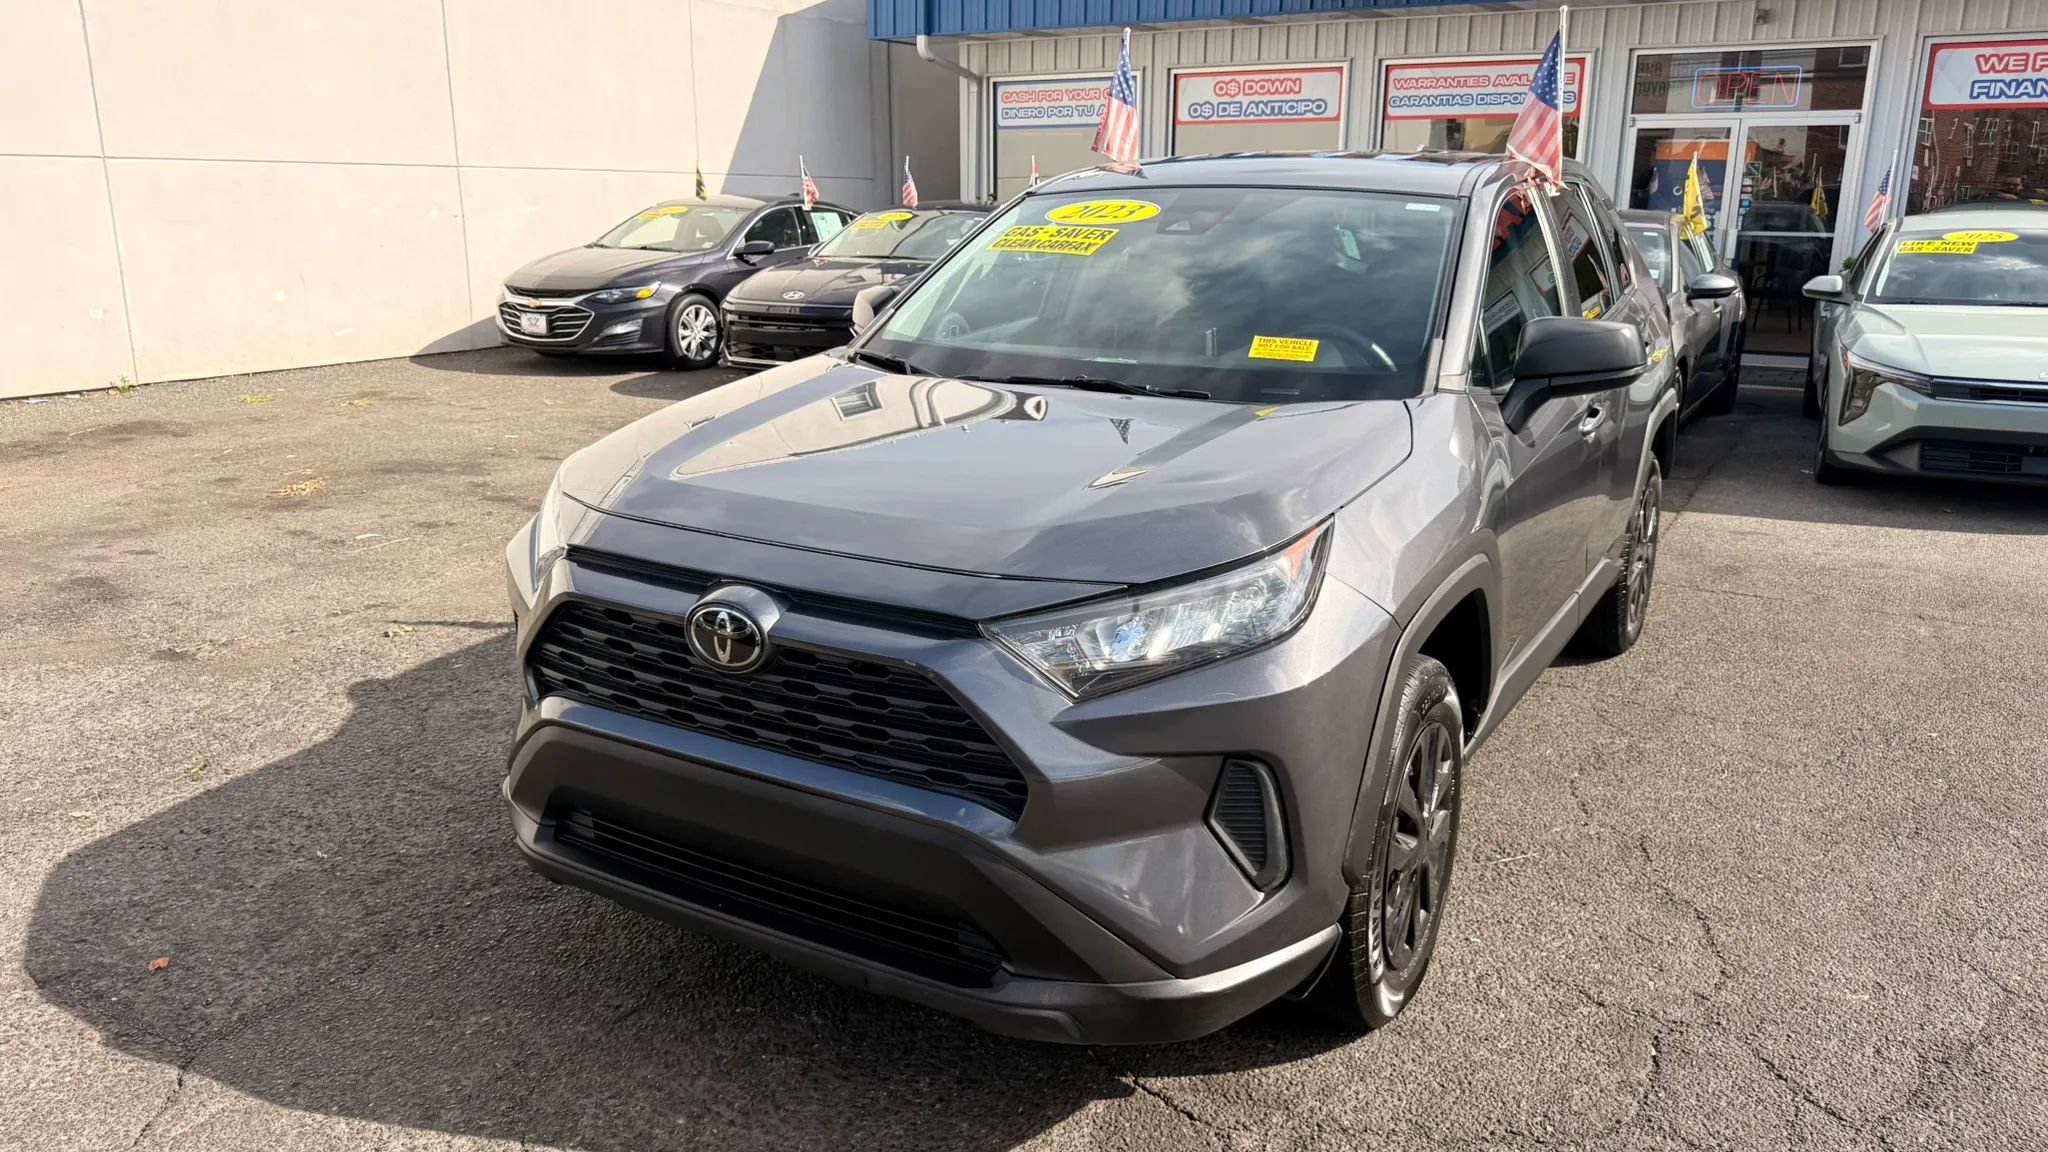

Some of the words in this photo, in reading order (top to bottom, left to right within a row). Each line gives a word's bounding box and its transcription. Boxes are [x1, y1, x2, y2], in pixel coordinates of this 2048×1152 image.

[1975, 53, 2029, 73] WE
[1242, 78, 1302, 95] DOWN
[1393, 75, 1489, 90] WARRANTIES
[1493, 73, 1575, 87] AVAILE
[1697, 71, 1799, 105] OPEN
[1002, 91, 1036, 103] CASH
[1038, 90, 1063, 102] FOR
[1066, 88, 1099, 101] YOUR
[1389, 93, 1473, 108] GARANTIAS
[1002, 107, 1045, 119] DINERO
[1047, 106, 1073, 118] POR
[1076, 105, 1094, 116] TU
[1217, 101, 1242, 118] DE
[1244, 98, 1327, 116] ANTICIPO
[1060, 204, 1147, 219] 2023
[1004, 227, 1040, 238] GAS
[1051, 227, 1113, 241] SAVER
[992, 238, 1038, 249] CLEAN
[1036, 239, 1098, 252] CARFAX
[1279, 338, 1313, 347] VEHICLE
